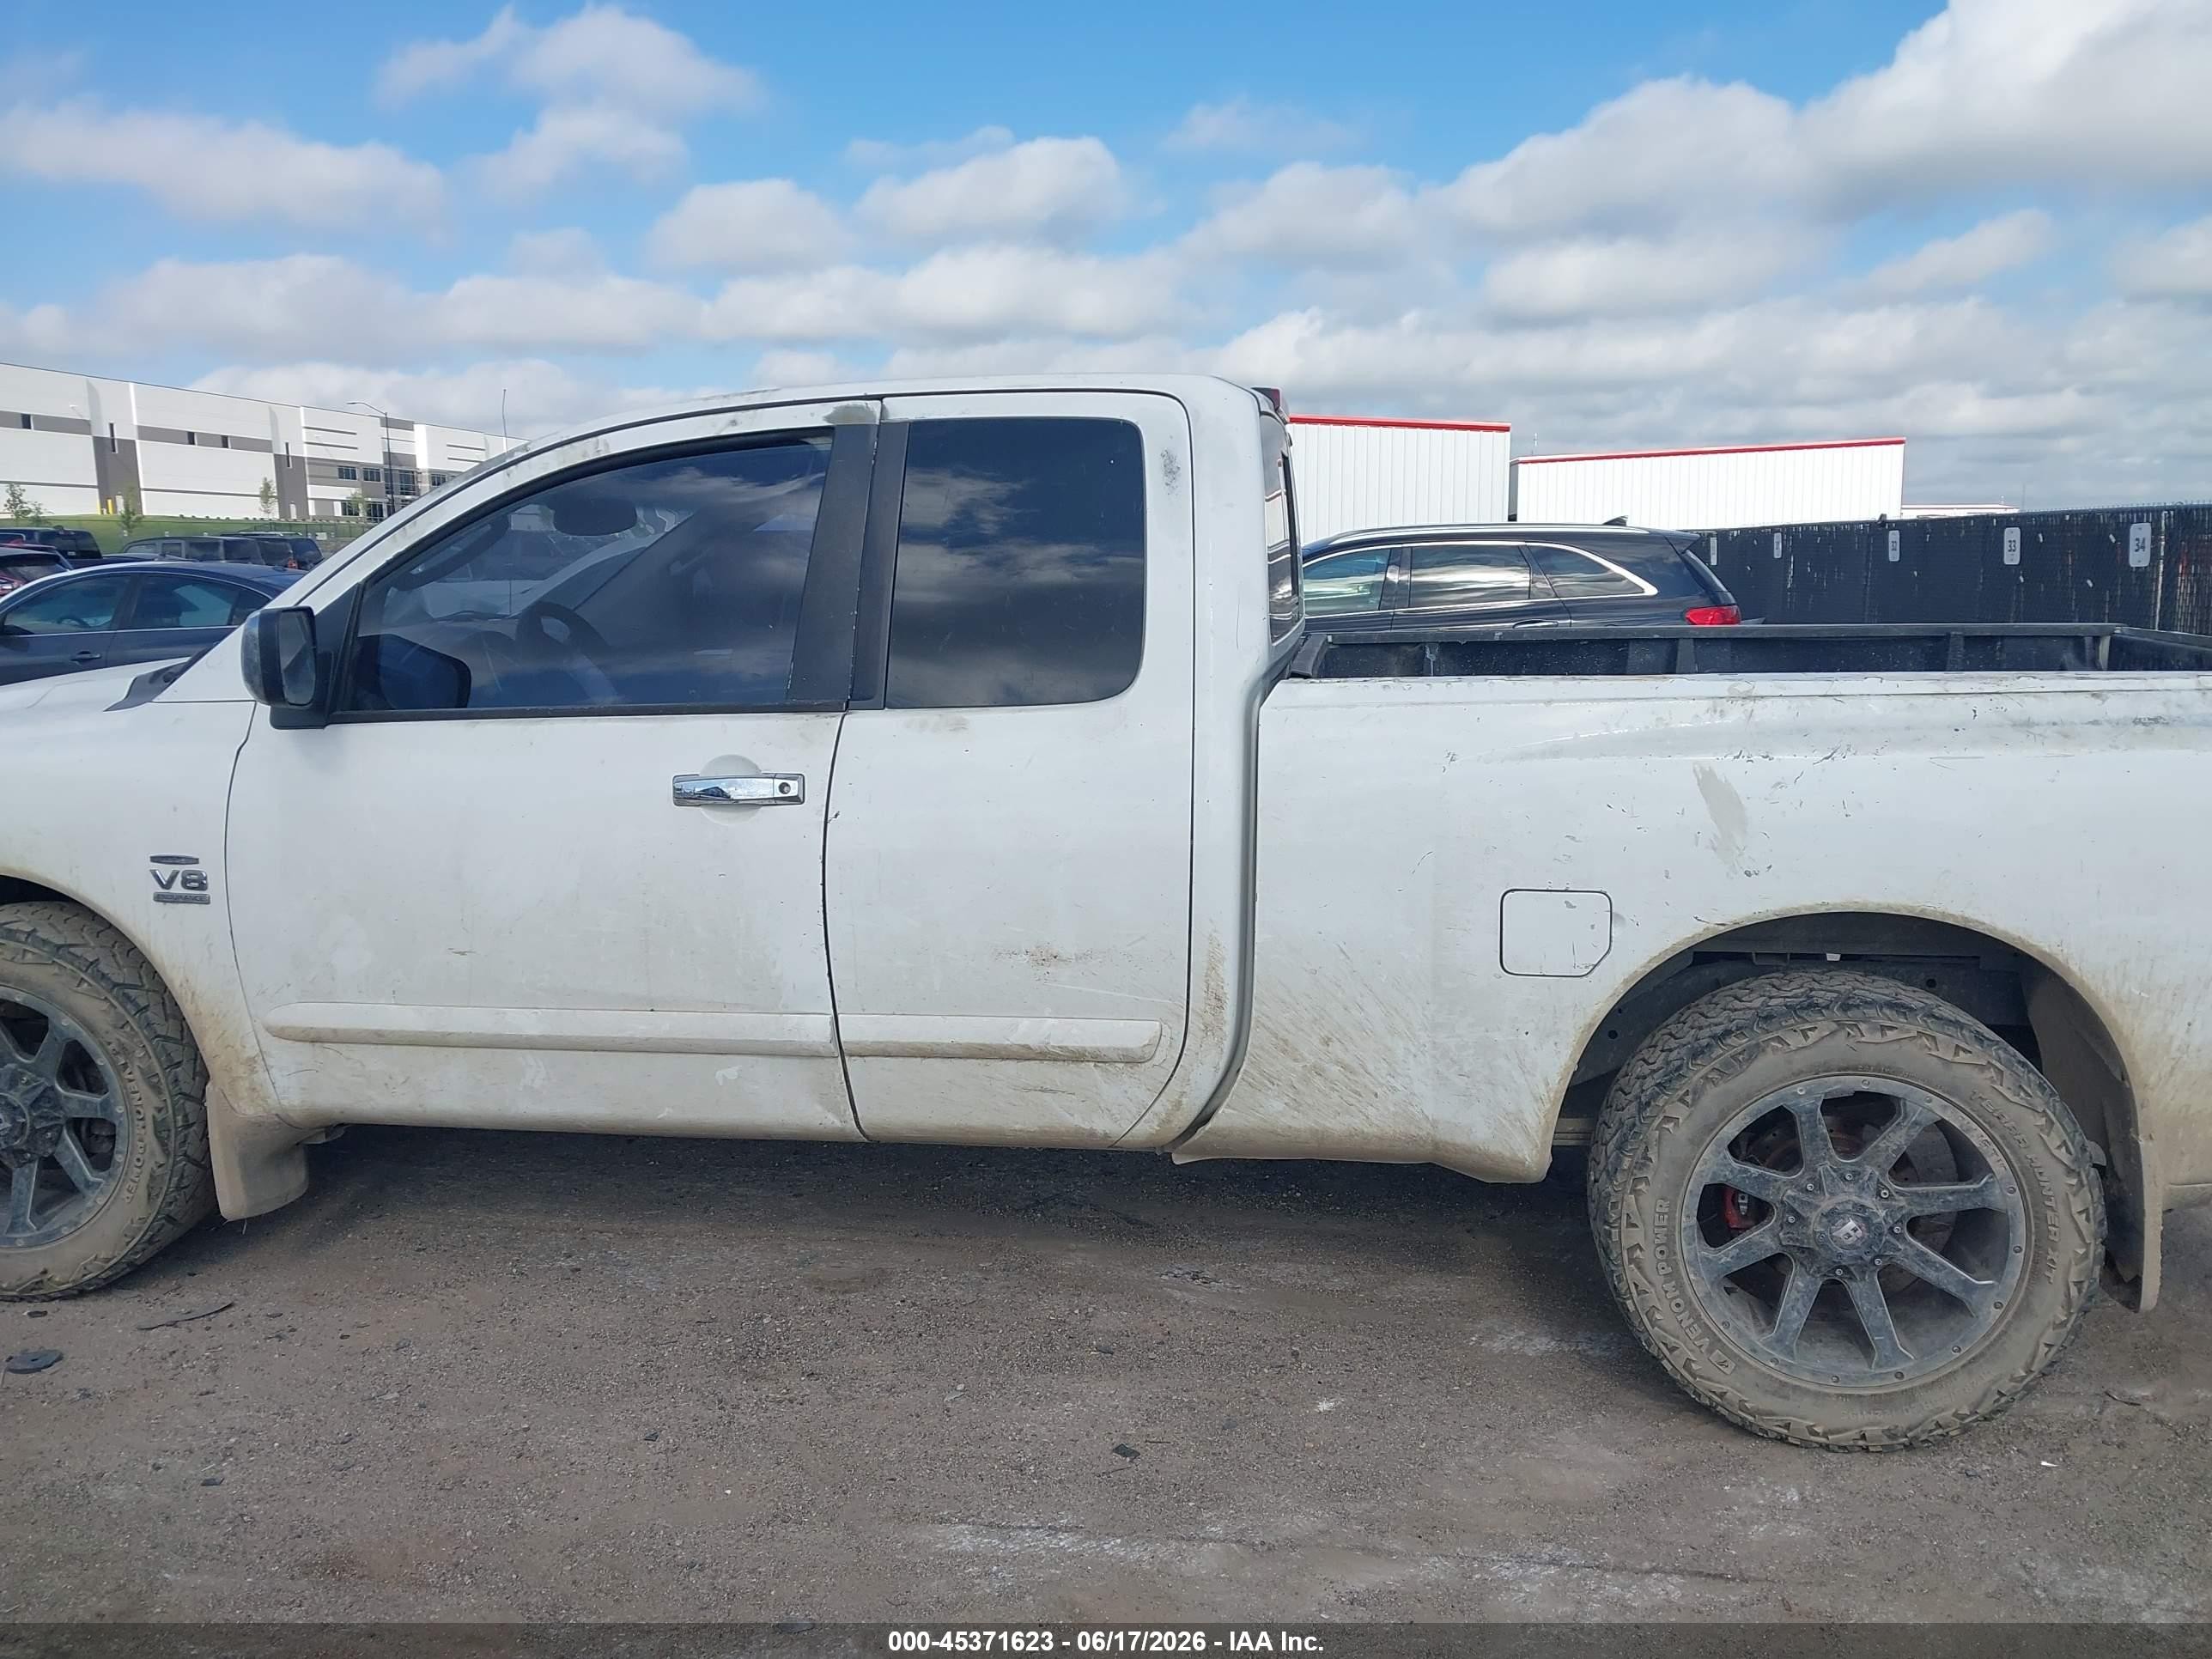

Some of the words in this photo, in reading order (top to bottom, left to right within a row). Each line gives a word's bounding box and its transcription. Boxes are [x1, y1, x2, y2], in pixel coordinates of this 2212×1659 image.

[2008, 539, 2017, 552] 33
[2134, 538, 2146, 552] 34
[149, 869, 209, 891] V8
[2026, 1153, 2060, 1243] HUNTER
[1652, 1198, 1673, 1277] POWER
[1662, 1280, 1711, 1354] VENOM
